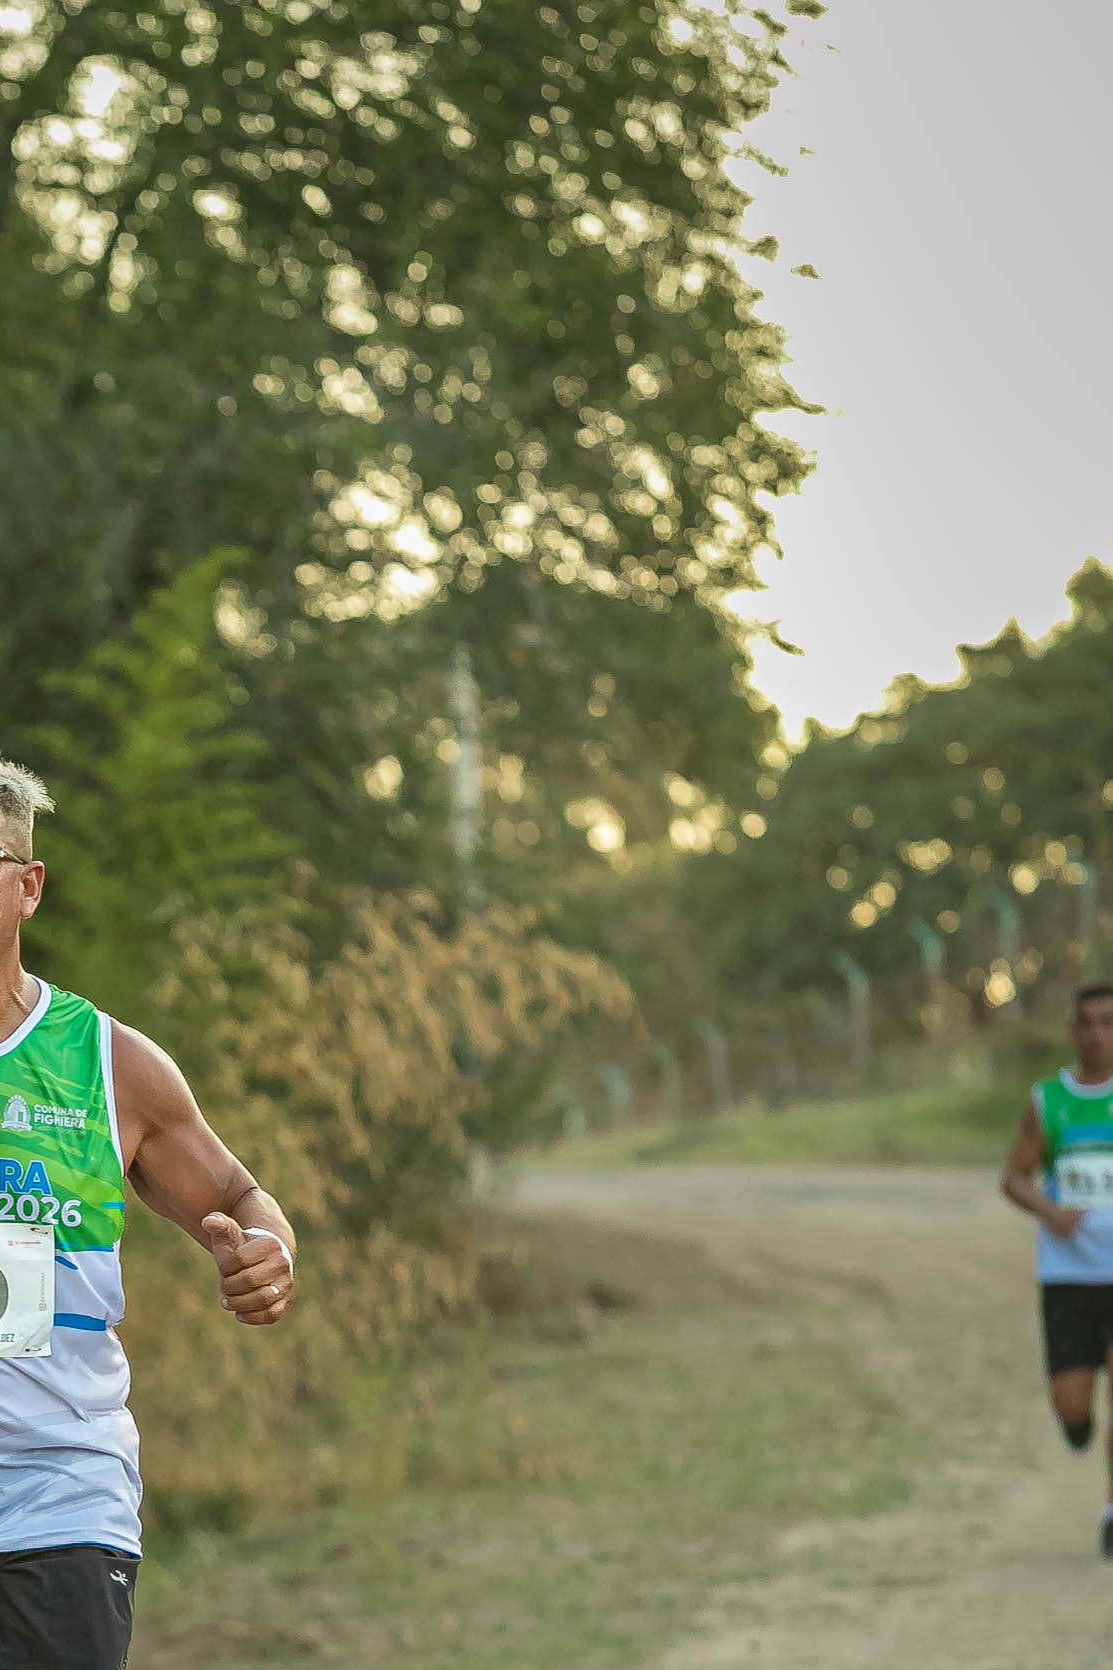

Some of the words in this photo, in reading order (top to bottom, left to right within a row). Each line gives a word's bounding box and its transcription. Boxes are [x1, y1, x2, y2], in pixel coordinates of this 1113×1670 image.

[34, 1104, 73, 1116] COMUNA
[75, 1109, 88, 1118] DE
[34, 1113, 86, 1129] FIGHIERA
